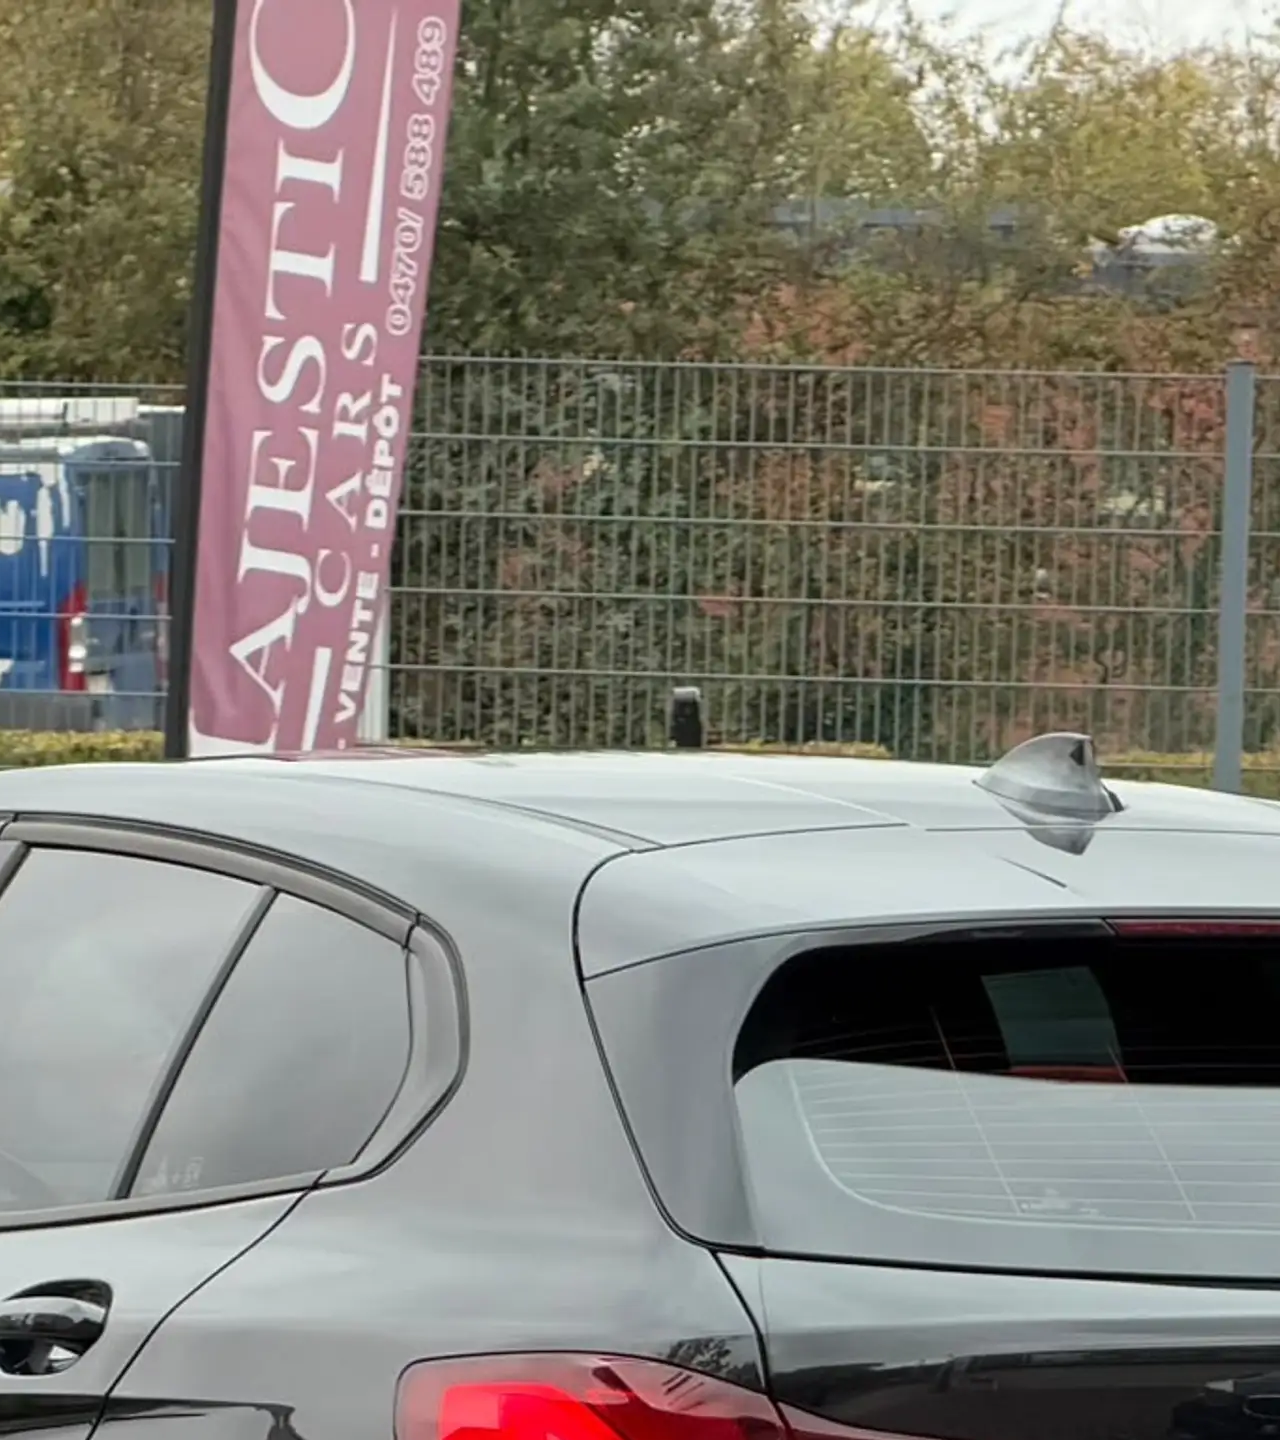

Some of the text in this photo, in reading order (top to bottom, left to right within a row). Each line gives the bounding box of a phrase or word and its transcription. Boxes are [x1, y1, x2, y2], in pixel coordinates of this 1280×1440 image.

[188, 0, 356, 757] AJESTIC
[315, 322, 378, 607] CARS
[333, 571, 379, 723] VENTE
[412, 16, 447, 105] 489
